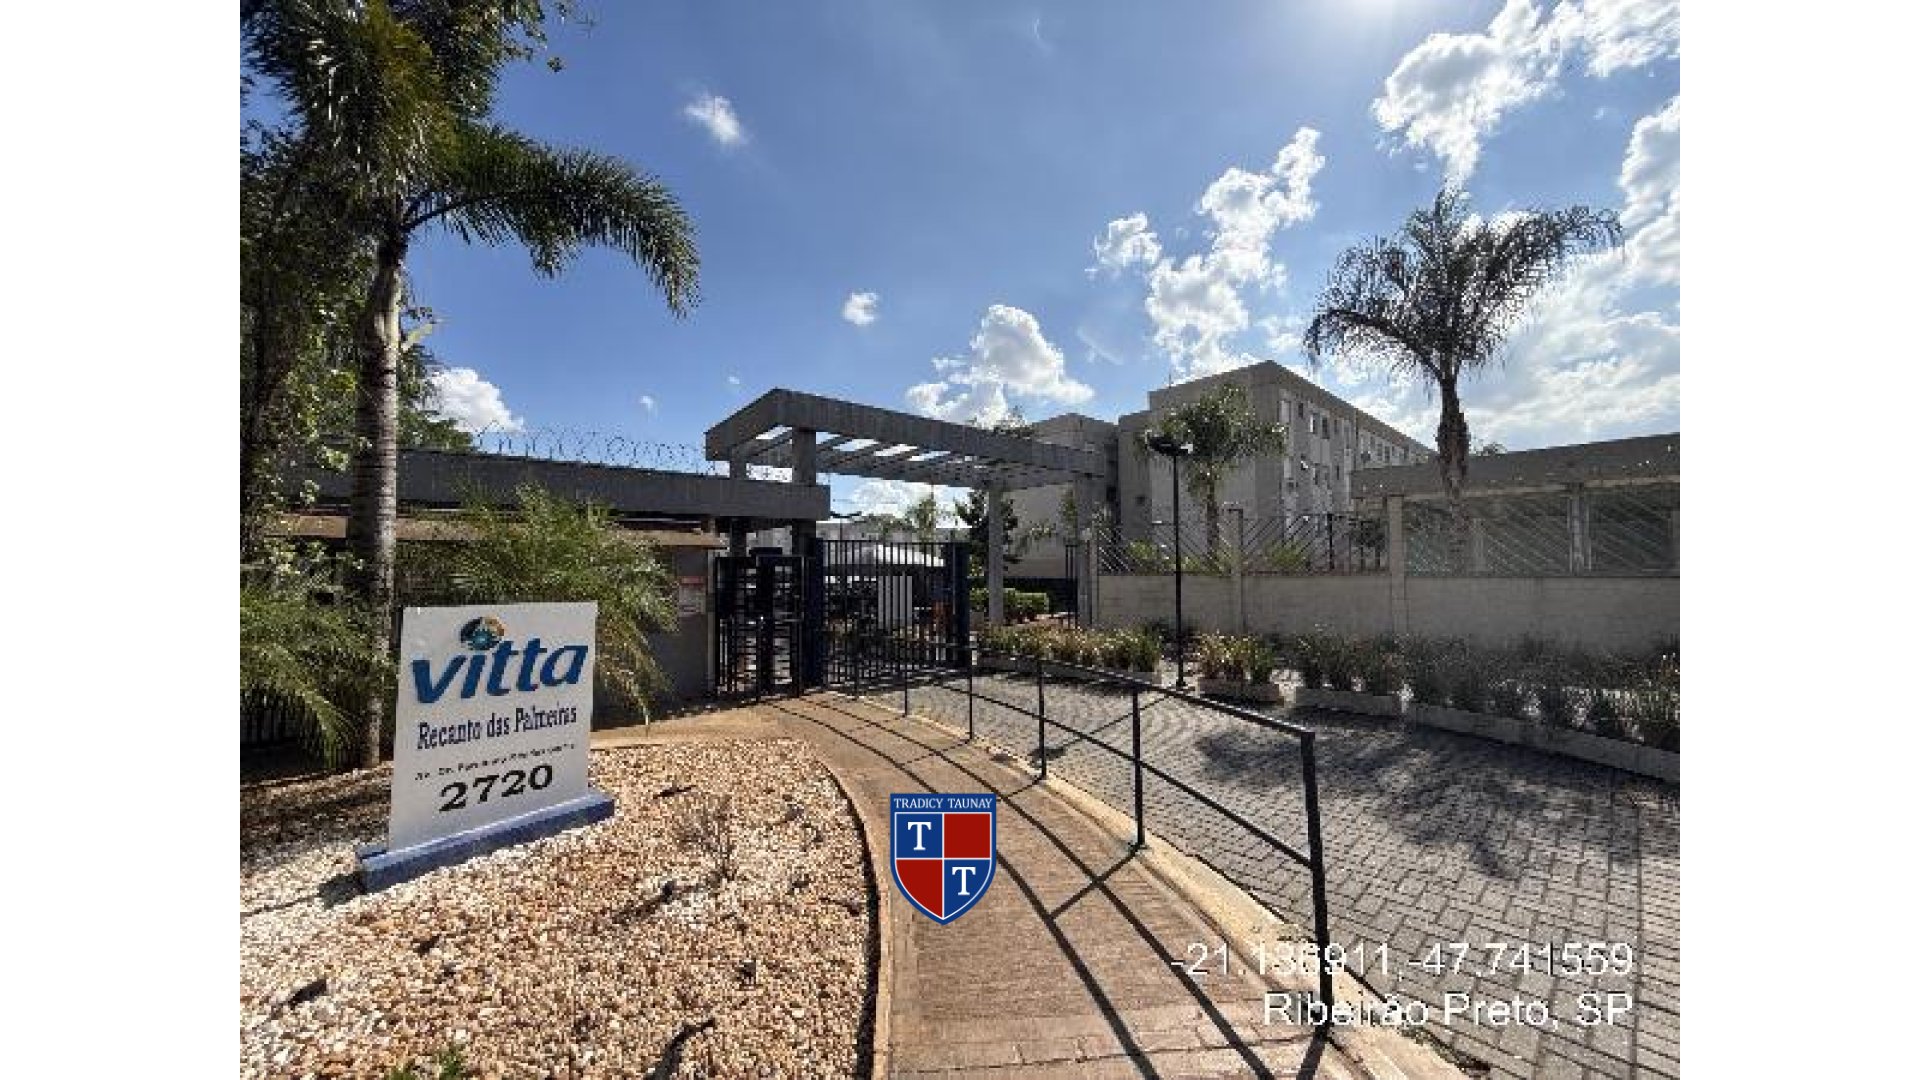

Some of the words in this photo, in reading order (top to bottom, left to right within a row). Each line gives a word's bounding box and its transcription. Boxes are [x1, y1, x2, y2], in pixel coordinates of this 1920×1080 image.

[412, 638, 588, 703] vitta
[417, 719, 481, 750] Recanto
[487, 712, 510, 738] das
[513, 702, 577, 733] Palmeiras
[438, 763, 553, 812] 2720
